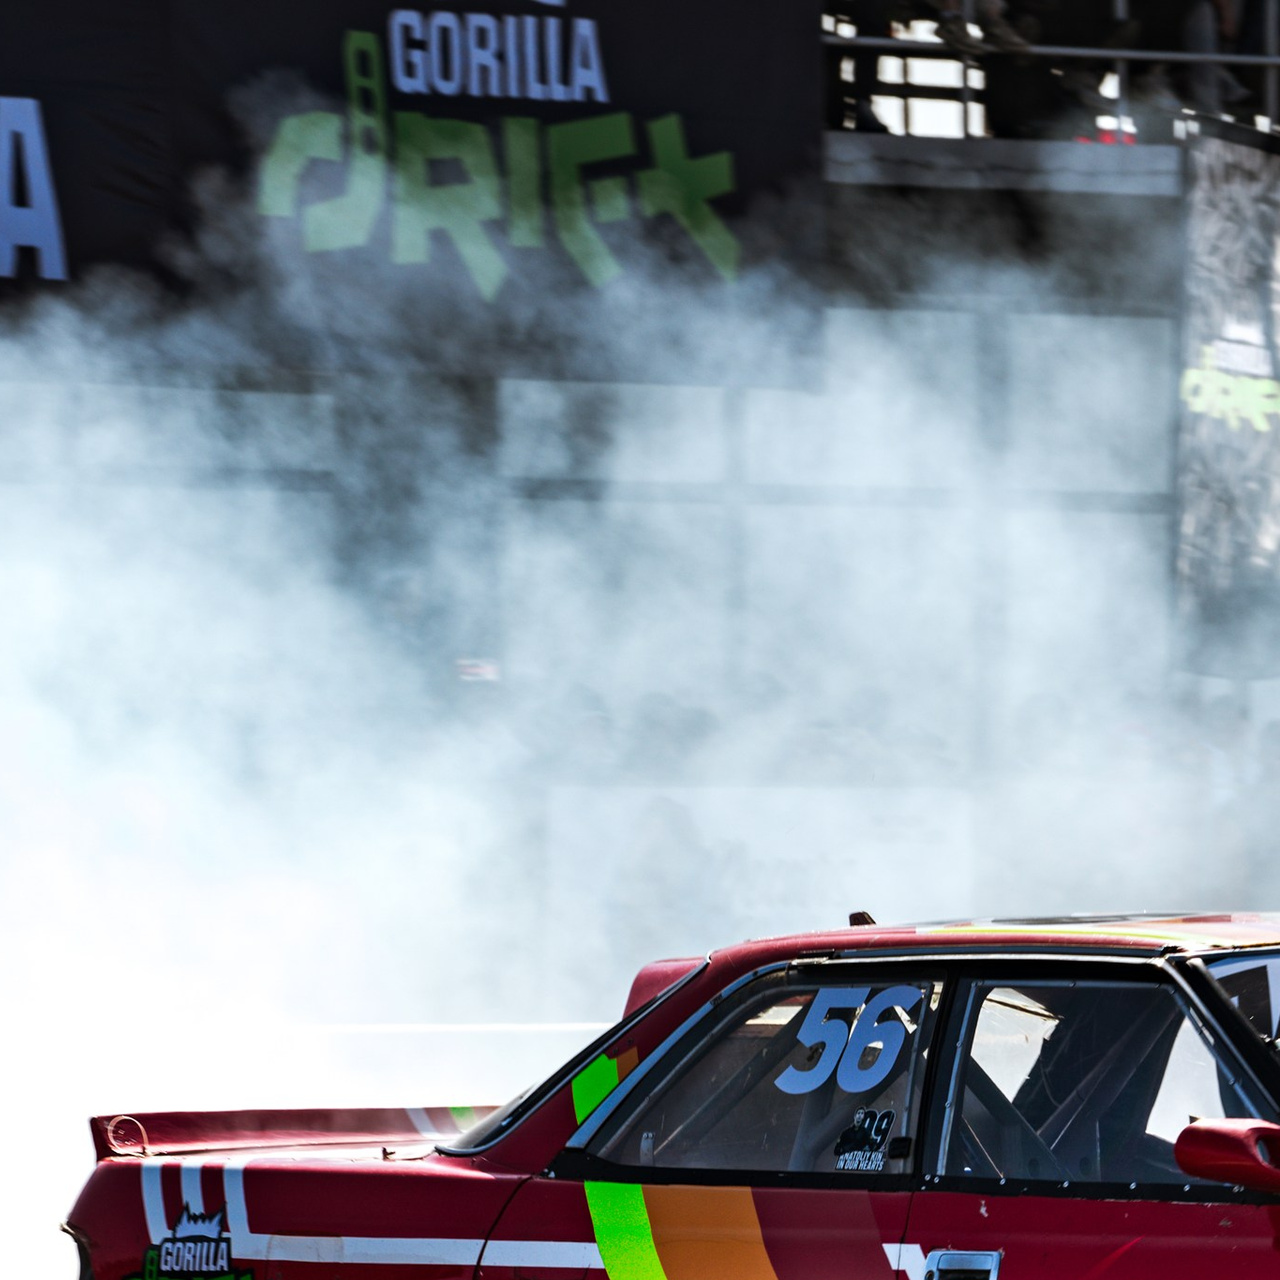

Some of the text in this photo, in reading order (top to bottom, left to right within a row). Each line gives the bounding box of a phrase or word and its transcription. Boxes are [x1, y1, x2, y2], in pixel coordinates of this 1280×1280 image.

[390, 8, 609, 103] GORILLA
[774, 985, 924, 1094] 56
[858, 1161, 884, 1171] HEARTS
[160, 1242, 229, 1271] GORILLA
